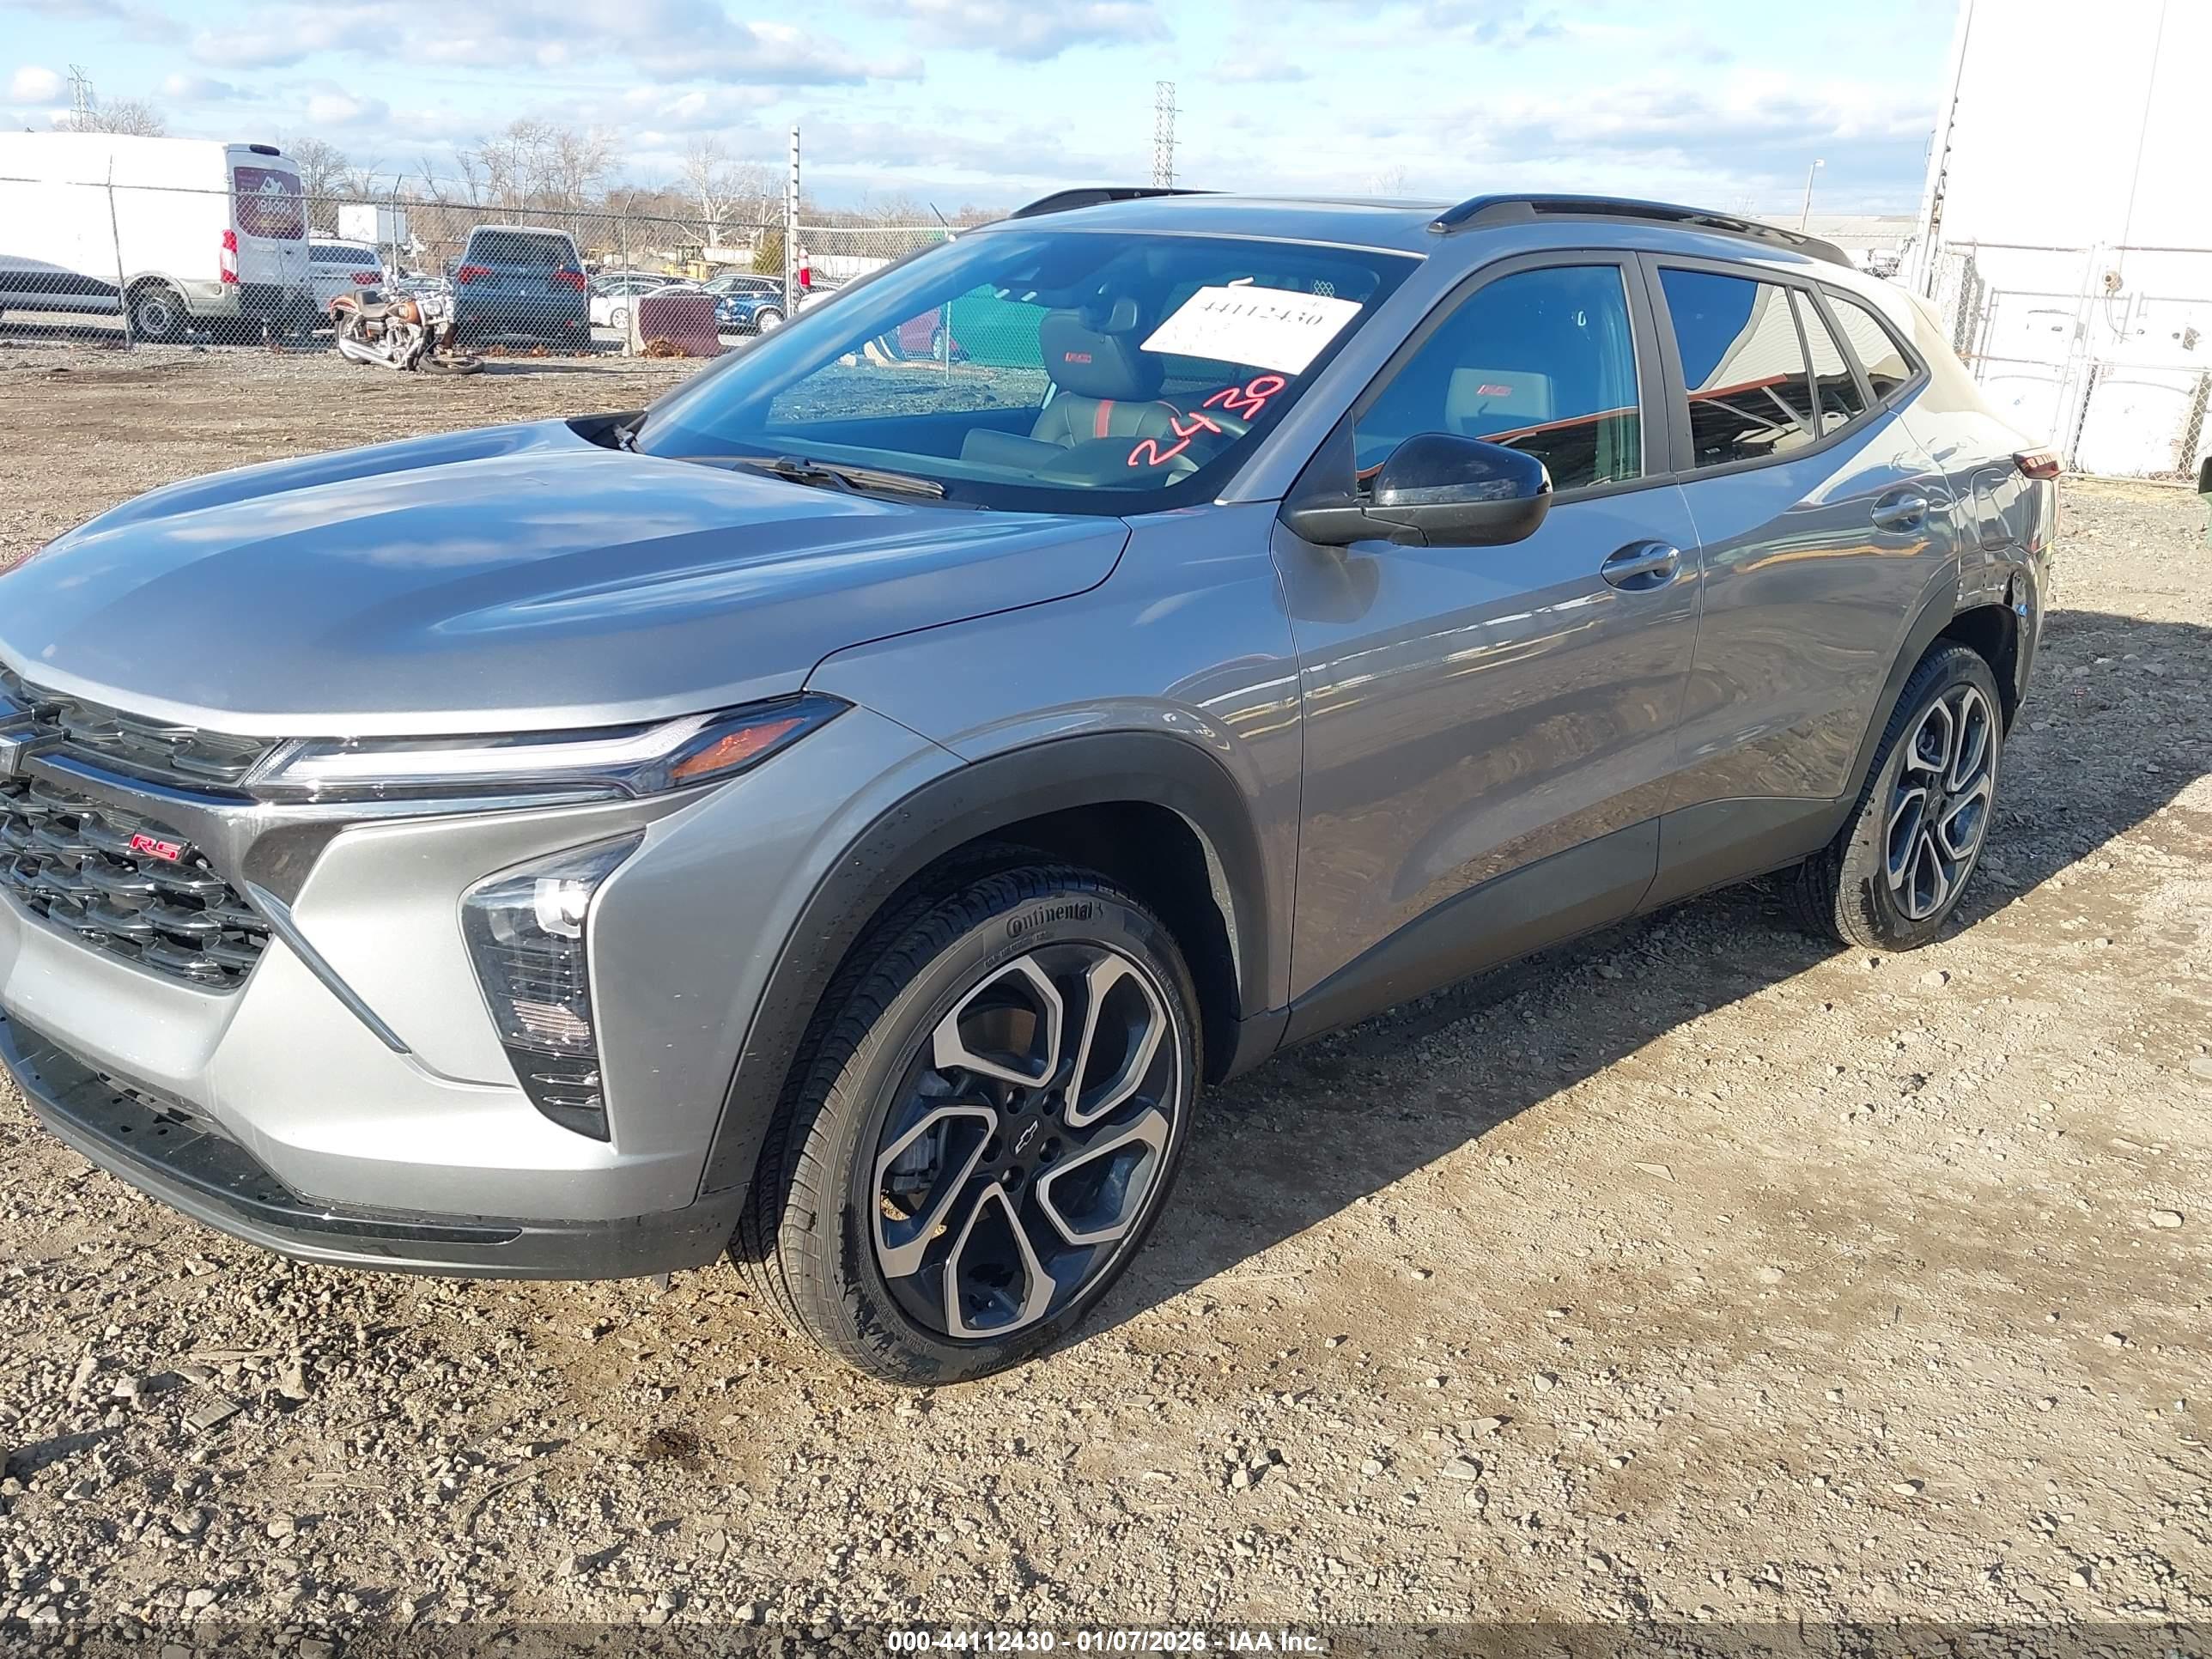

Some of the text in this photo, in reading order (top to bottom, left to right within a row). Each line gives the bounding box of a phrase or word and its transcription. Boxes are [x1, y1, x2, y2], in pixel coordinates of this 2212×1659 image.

[1127, 374, 1285, 467] 2430
[130, 832, 181, 861] RS
[1006, 902, 1093, 939] Continental
